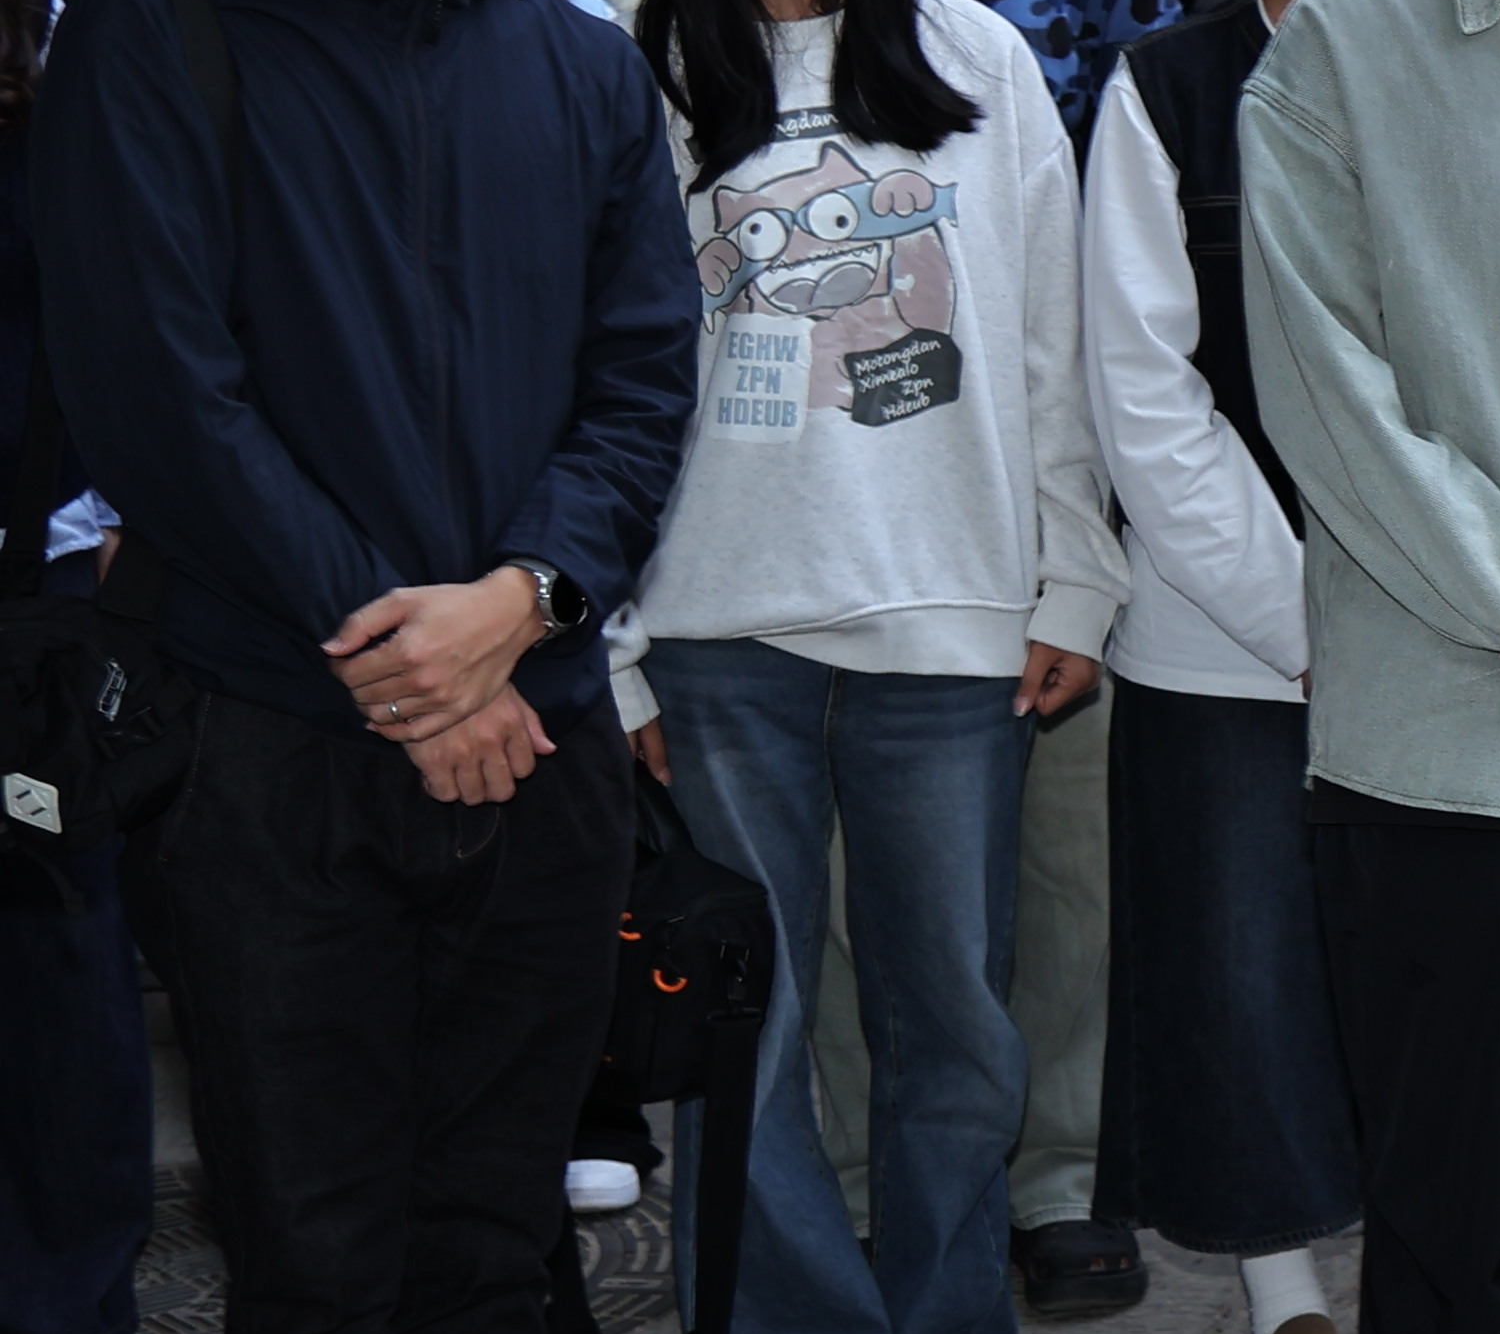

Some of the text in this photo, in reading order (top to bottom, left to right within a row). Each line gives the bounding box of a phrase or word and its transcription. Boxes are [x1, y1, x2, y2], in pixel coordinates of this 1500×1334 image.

[727, 331, 799, 363] EGHW
[736, 366, 782, 395] ZPN
[717, 397, 798, 428] HDEUB
